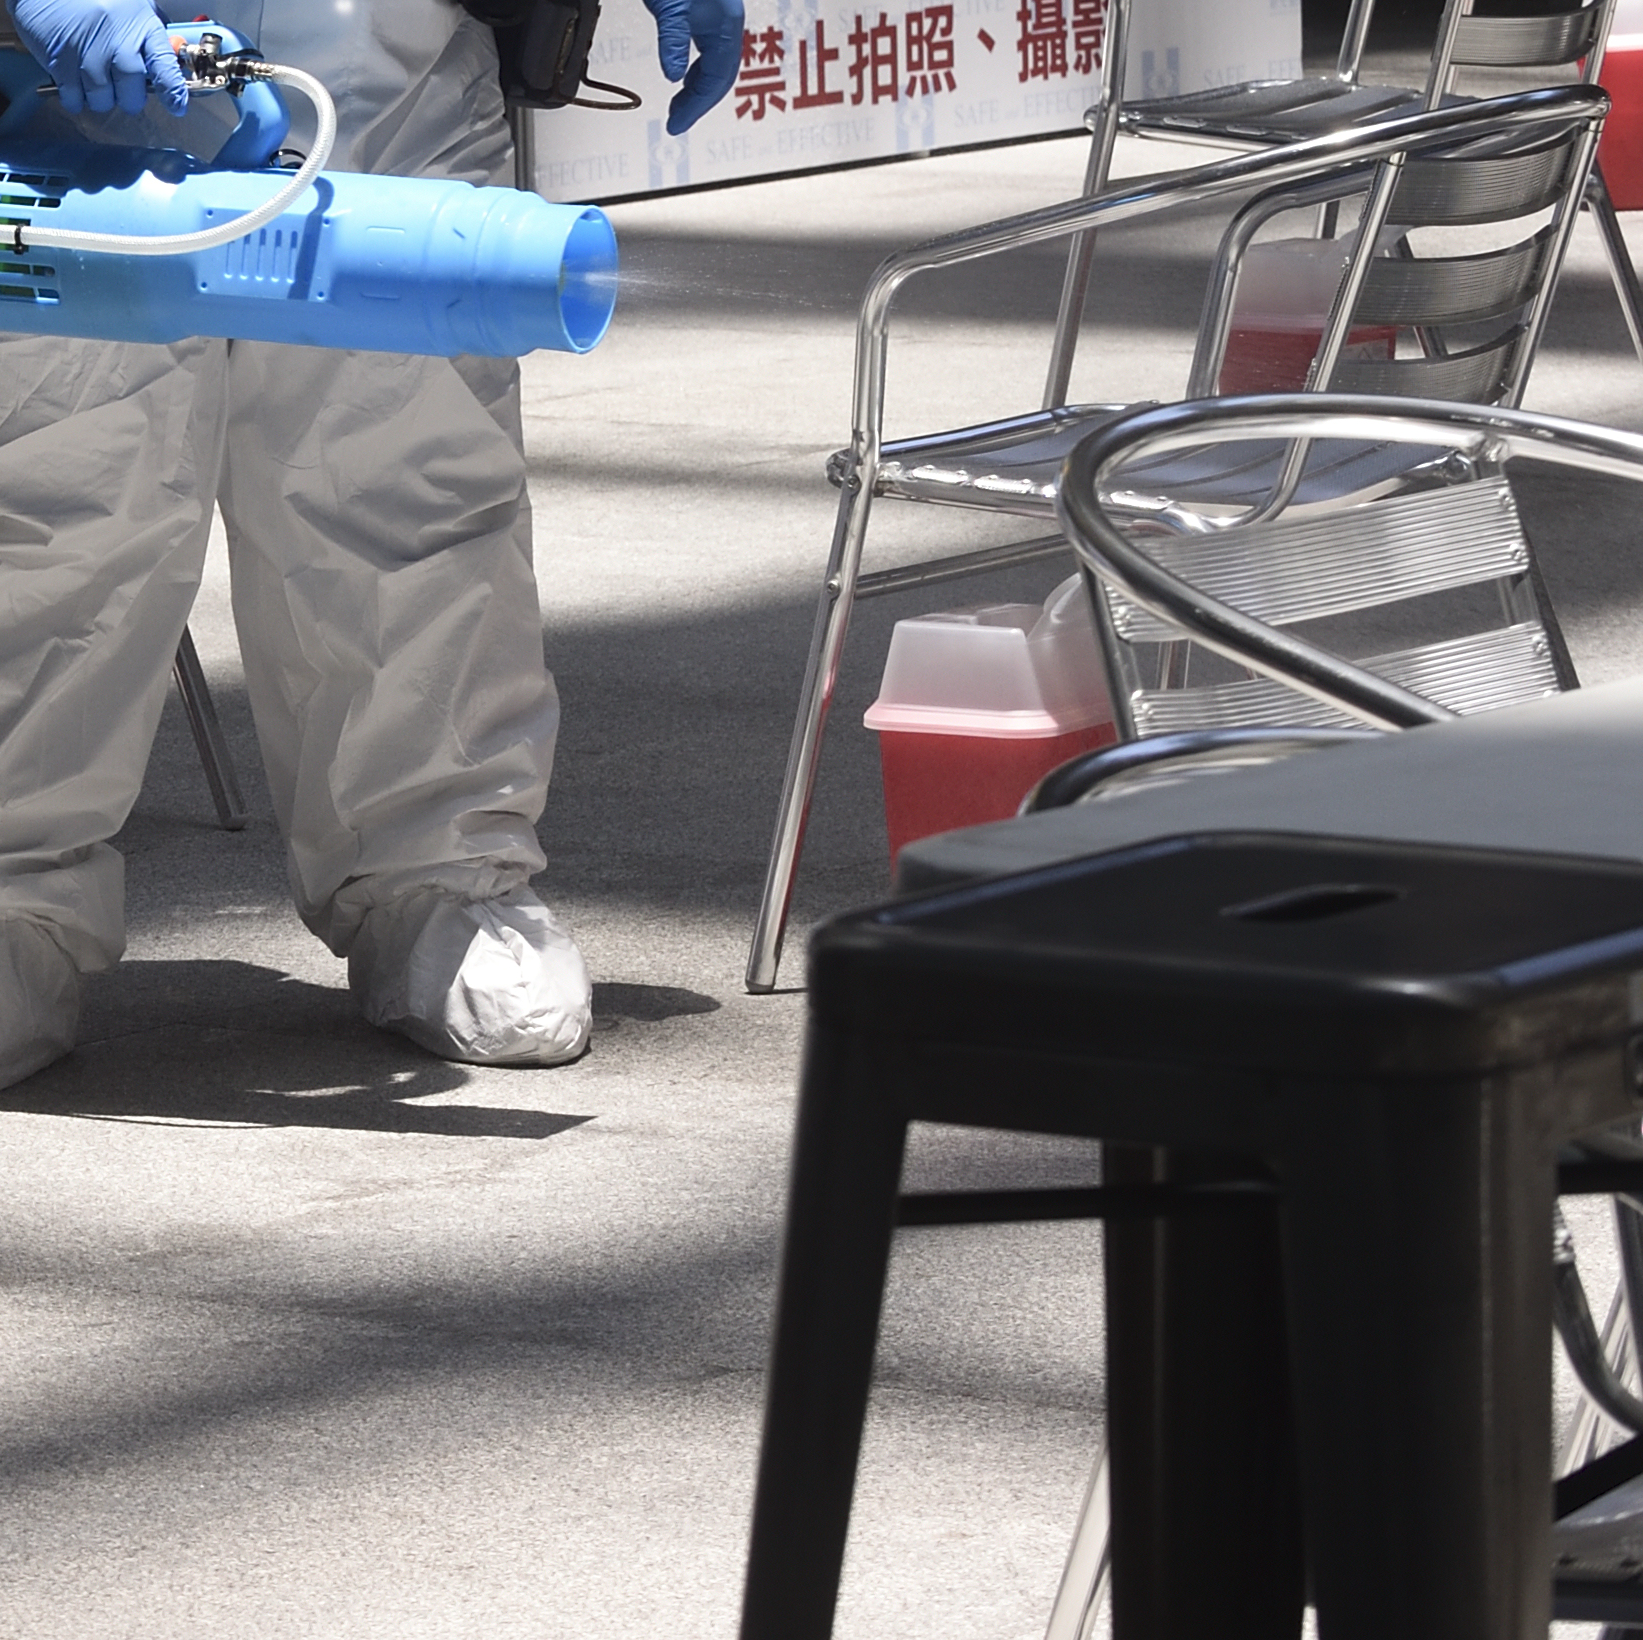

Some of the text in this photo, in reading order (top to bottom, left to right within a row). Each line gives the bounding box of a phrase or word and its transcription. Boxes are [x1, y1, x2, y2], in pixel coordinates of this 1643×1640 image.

[955, 100, 999, 128] SAFE
[706, 118, 874, 162] SAFE EFFECTIVE
